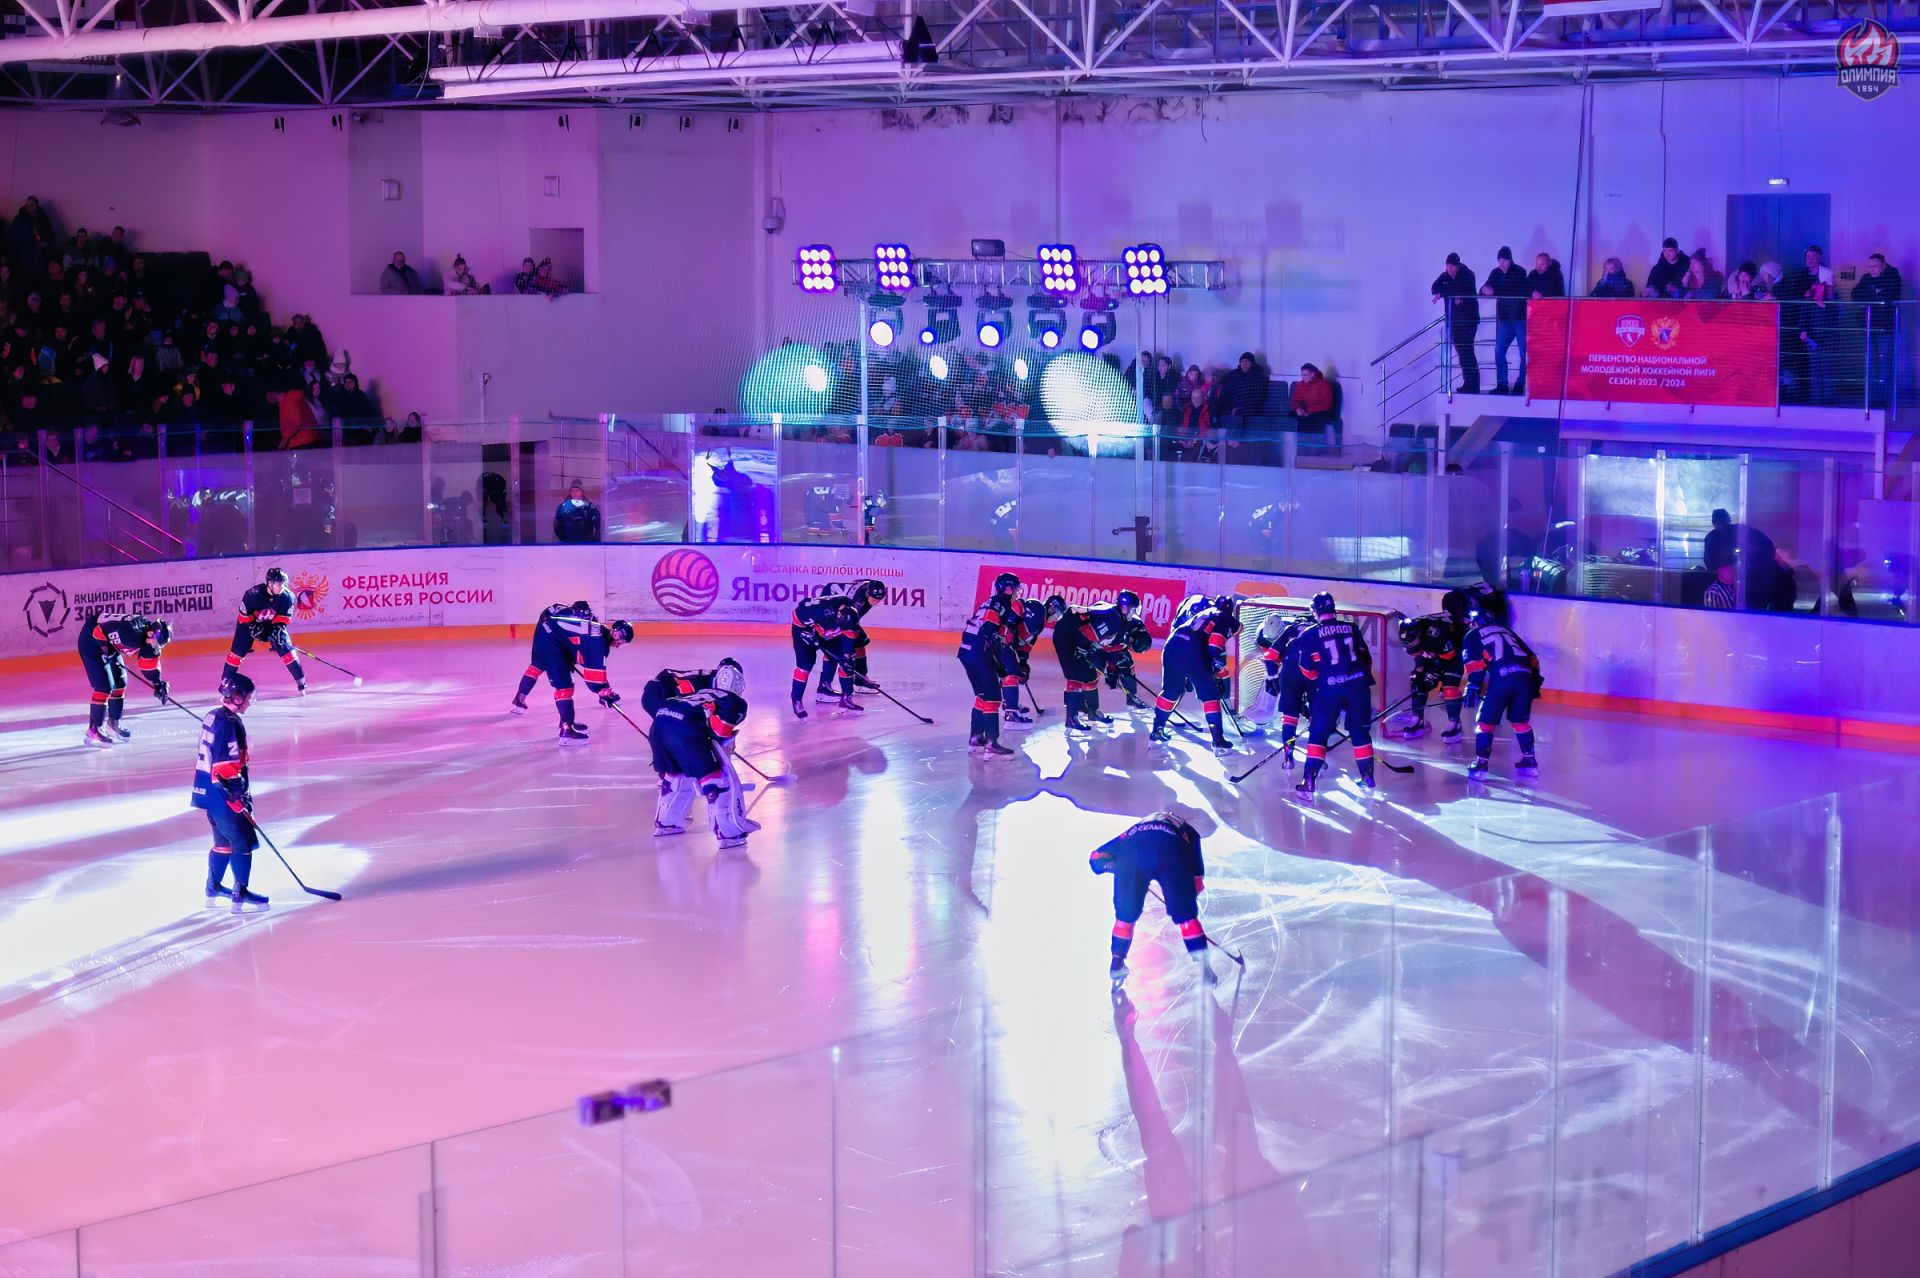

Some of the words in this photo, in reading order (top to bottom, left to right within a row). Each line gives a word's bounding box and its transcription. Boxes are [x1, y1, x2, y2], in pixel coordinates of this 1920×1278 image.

[1588, 353, 1637, 364] ПЕРВЕНСТВО
[1637, 354, 1707, 366] НАЦИОНАЛЬНОЙ
[1642, 365, 1692, 376] ХОККЕЙНОЙ
[1693, 368, 1716, 377] ЛИГИ
[1608, 377, 1636, 386] СЕЗОН
[1637, 377, 1658, 386] 2023
[811, 565, 853, 576] РОЛЛОВ
[855, 566, 863, 576] И
[865, 566, 904, 578] ПИЦЦЫ
[342, 572, 449, 591] ФЕДЕРАЦИЯ
[74, 587, 150, 605] АКЦИОНЕРНОЕ
[154, 583, 213, 598] ОБЩЕСТВО
[342, 592, 413, 610] ХОККЕЯ
[419, 589, 493, 605] РОССИИ
[132, 595, 213, 616] СЕЛЬМАШ
[1323, 636, 1357, 666] 11
